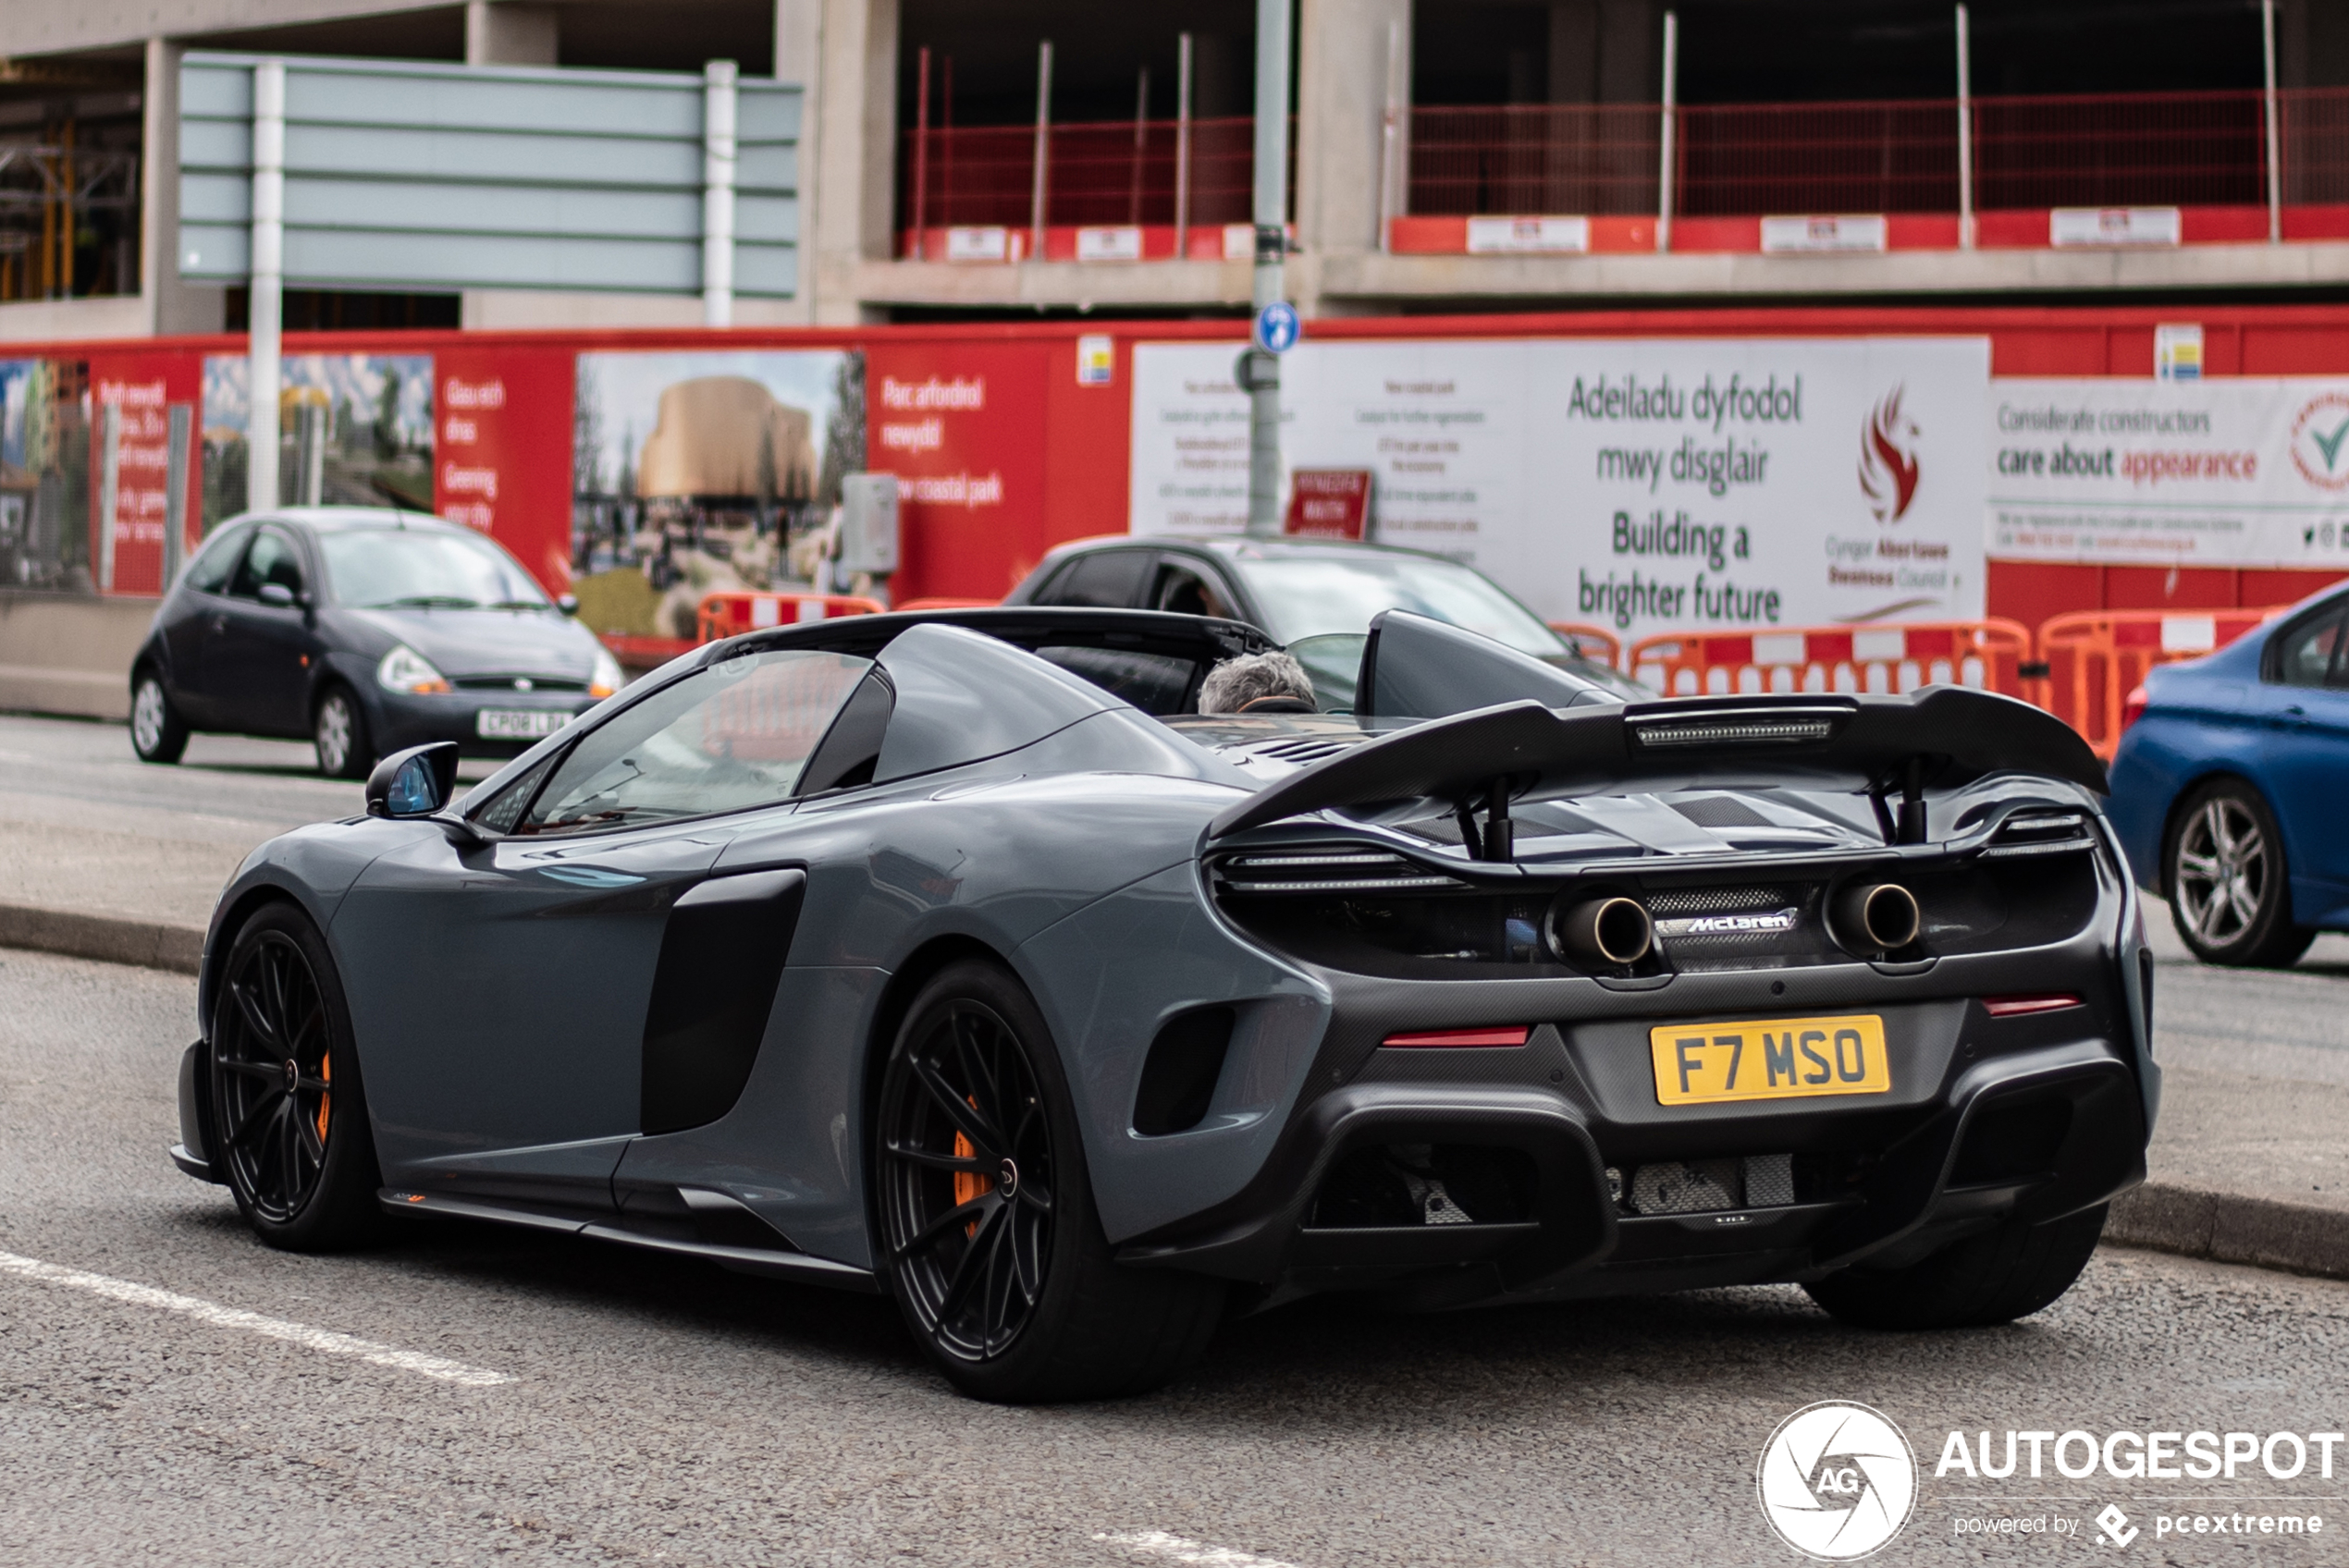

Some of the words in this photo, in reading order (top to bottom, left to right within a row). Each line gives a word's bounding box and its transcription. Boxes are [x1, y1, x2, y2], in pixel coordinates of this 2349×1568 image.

[883, 379, 913, 407] Parc
[916, 376, 982, 407] arfordirol
[1568, 374, 1684, 420] Adeiladu
[1691, 374, 1802, 434] dyfodol
[882, 418, 940, 453] newydd
[1998, 404, 2096, 434] Considerate
[2098, 407, 2211, 435] constructors
[1596, 448, 1663, 495] mwy
[1670, 435, 1769, 496] disglair
[1998, 449, 2045, 476] care
[2049, 441, 2114, 477] about
[2121, 451, 2258, 487] appearance
[917, 472, 966, 500] coastal
[969, 472, 1001, 508] park
[1613, 510, 1726, 572] Building
[1733, 525, 1750, 558] a
[1579, 568, 1686, 630] brighter
[1693, 572, 1780, 623] future
[1688, 916, 1789, 933] McLaren
[1675, 1035, 1744, 1094] F7
[1762, 1028, 1866, 1088] MSO
